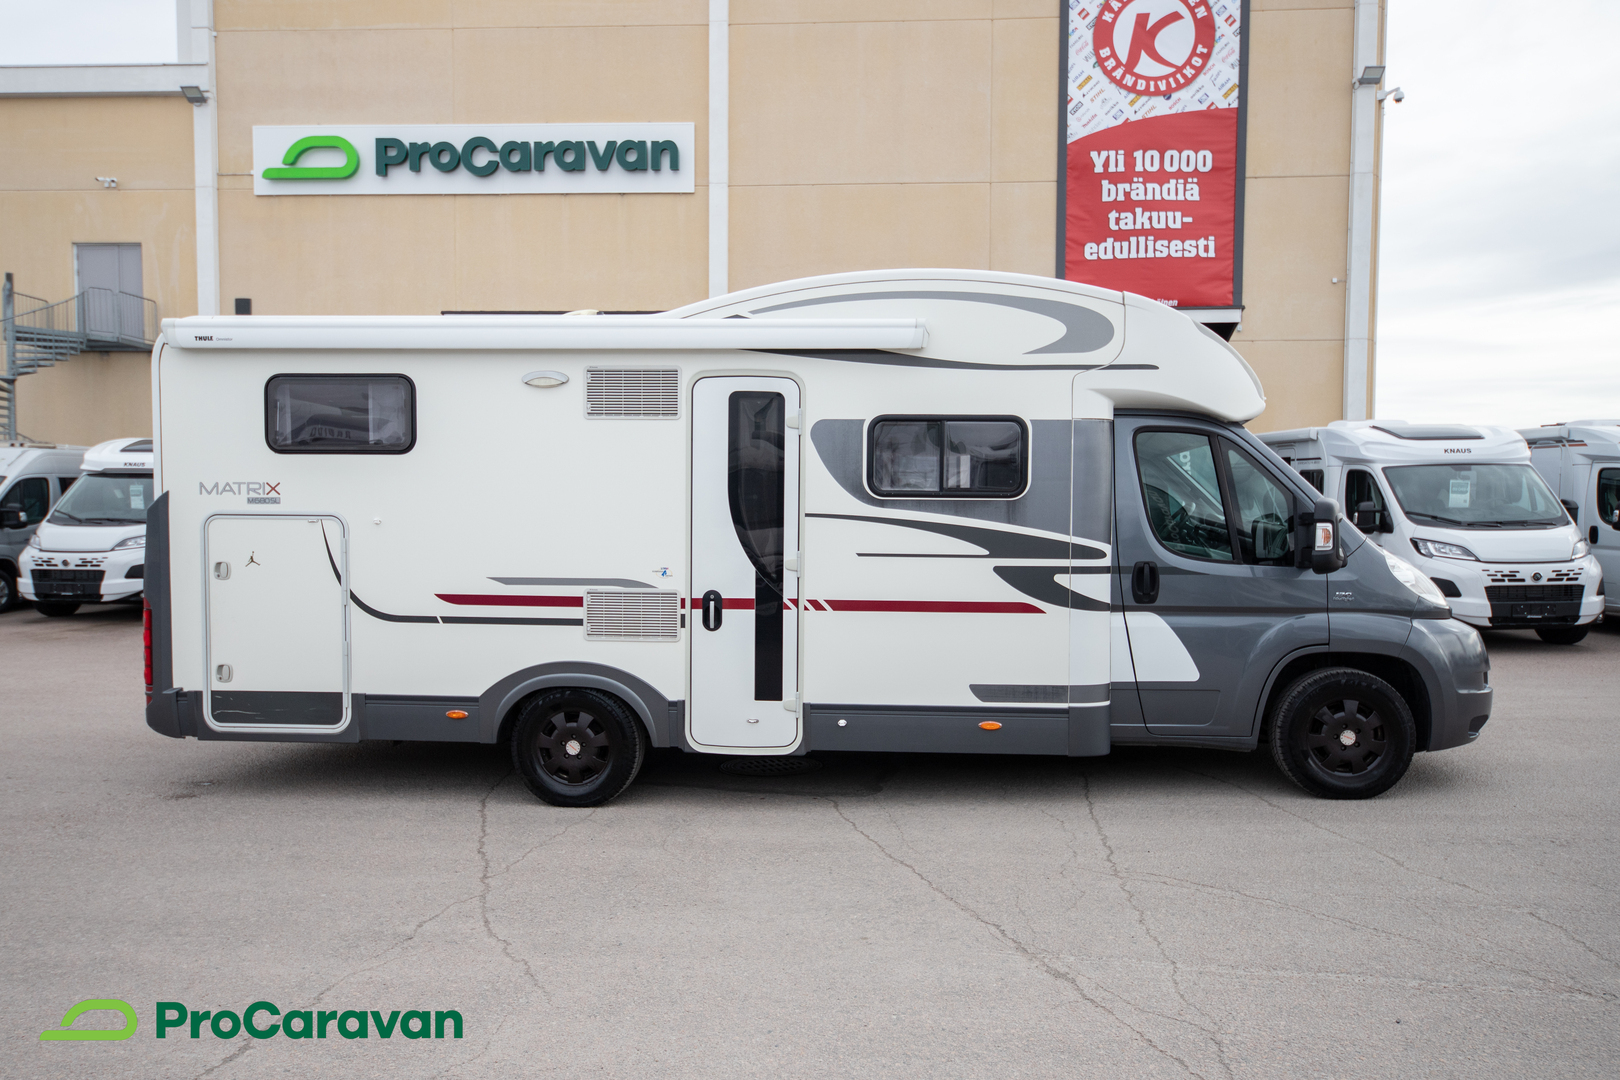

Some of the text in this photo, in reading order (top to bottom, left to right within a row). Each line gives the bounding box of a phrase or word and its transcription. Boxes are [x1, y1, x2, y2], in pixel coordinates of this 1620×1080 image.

[1099, 44, 1208, 92] BRÄNDIVIIKOT
[375, 136, 680, 177] ProCaravan
[1090, 150, 1125, 173] Yli
[1101, 177, 1200, 202] brändiä
[1108, 207, 1193, 230] takuu-
[1084, 236, 1216, 260] edullisesti
[199, 481, 281, 496] MATRIX
